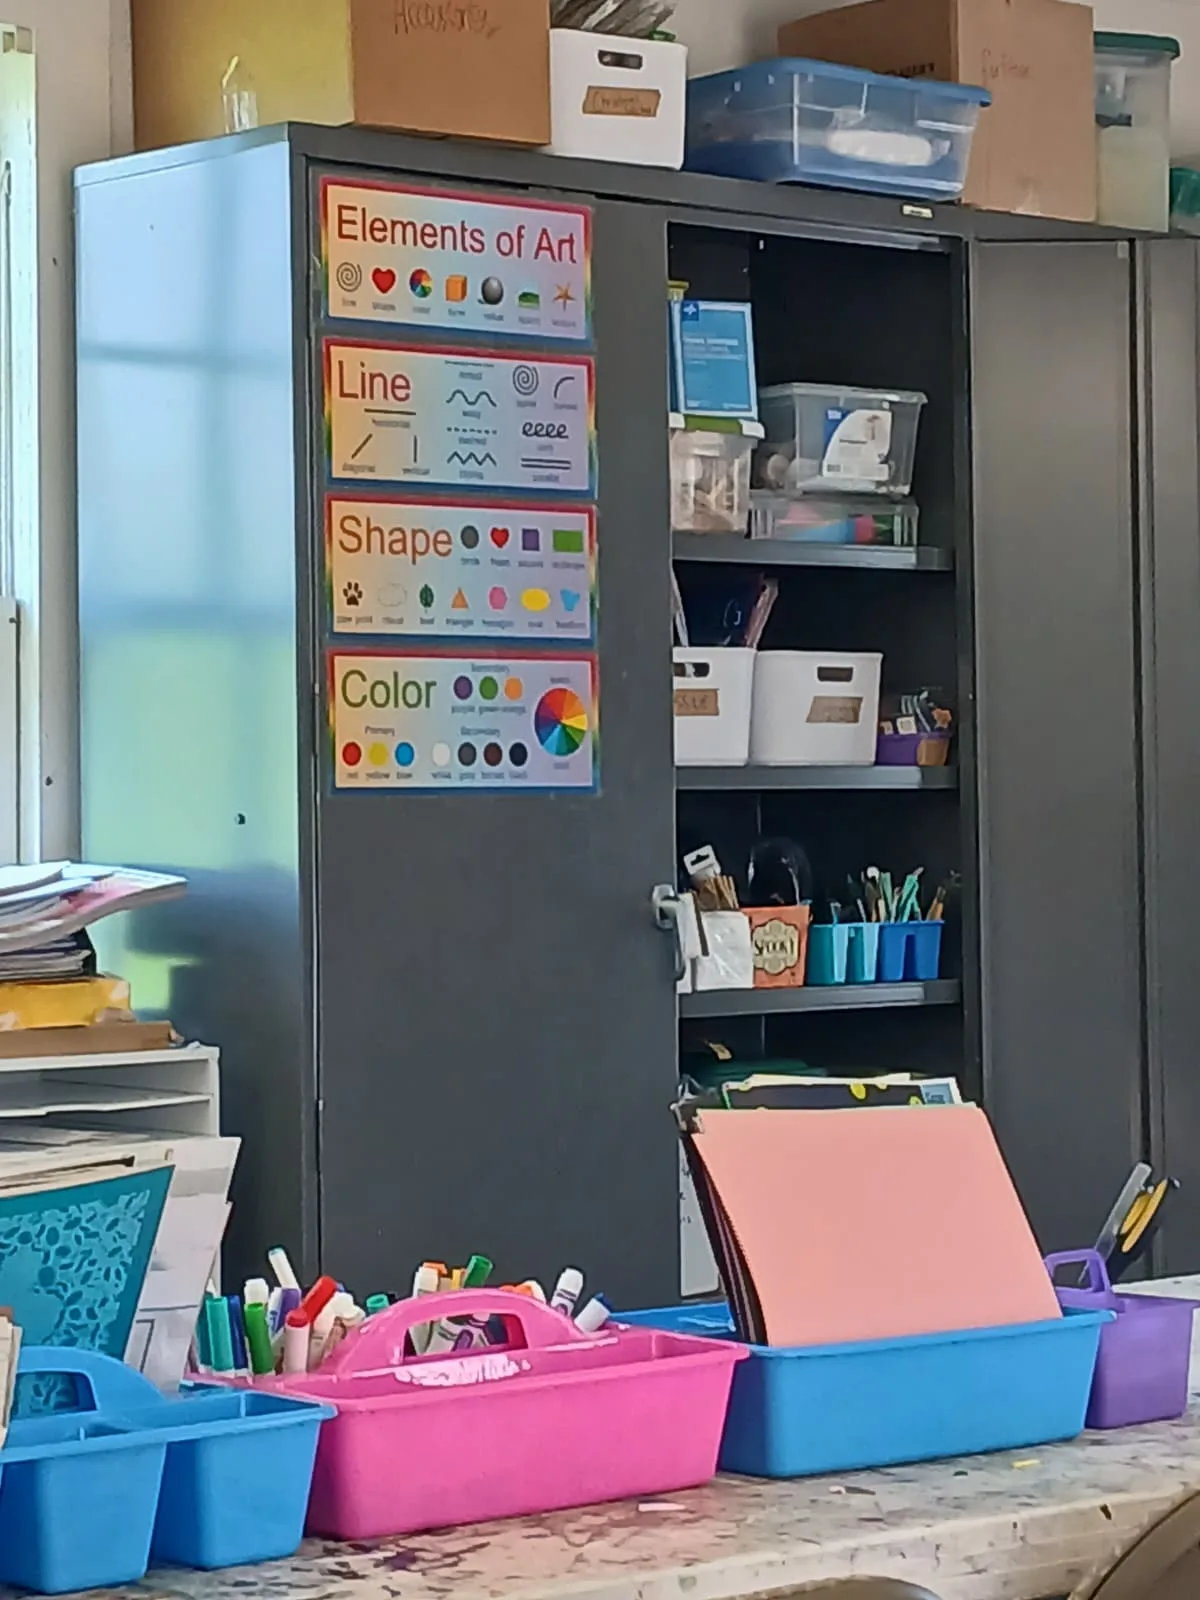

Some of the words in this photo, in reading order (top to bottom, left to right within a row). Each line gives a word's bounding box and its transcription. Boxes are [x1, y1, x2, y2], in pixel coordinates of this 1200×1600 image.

[337, 204, 486, 254] Elements
[496, 224, 526, 259] of
[533, 227, 578, 264] Art
[338, 359, 412, 402] Line
[338, 514, 453, 566] Shape
[341, 669, 437, 709] Color
